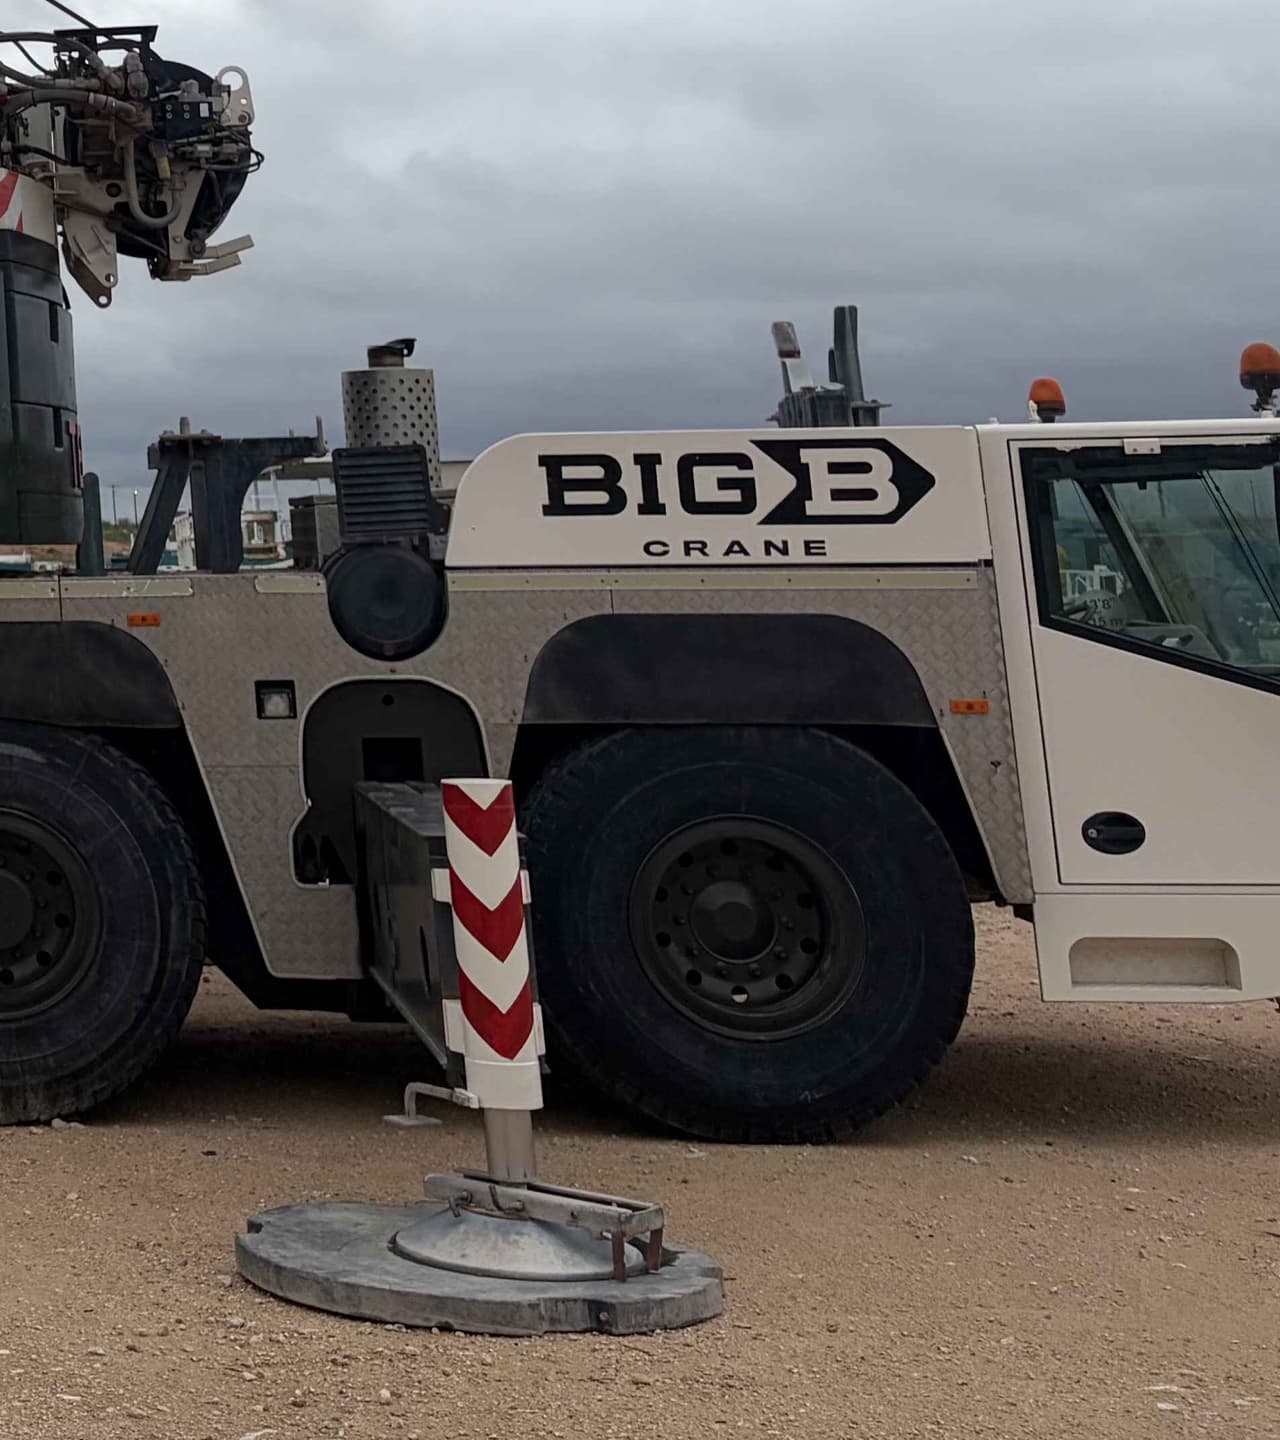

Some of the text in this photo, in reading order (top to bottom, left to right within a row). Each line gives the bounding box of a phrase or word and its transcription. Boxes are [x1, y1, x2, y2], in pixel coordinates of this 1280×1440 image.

[538, 447, 900, 517] BIG B
[643, 539, 827, 557] CRANE
